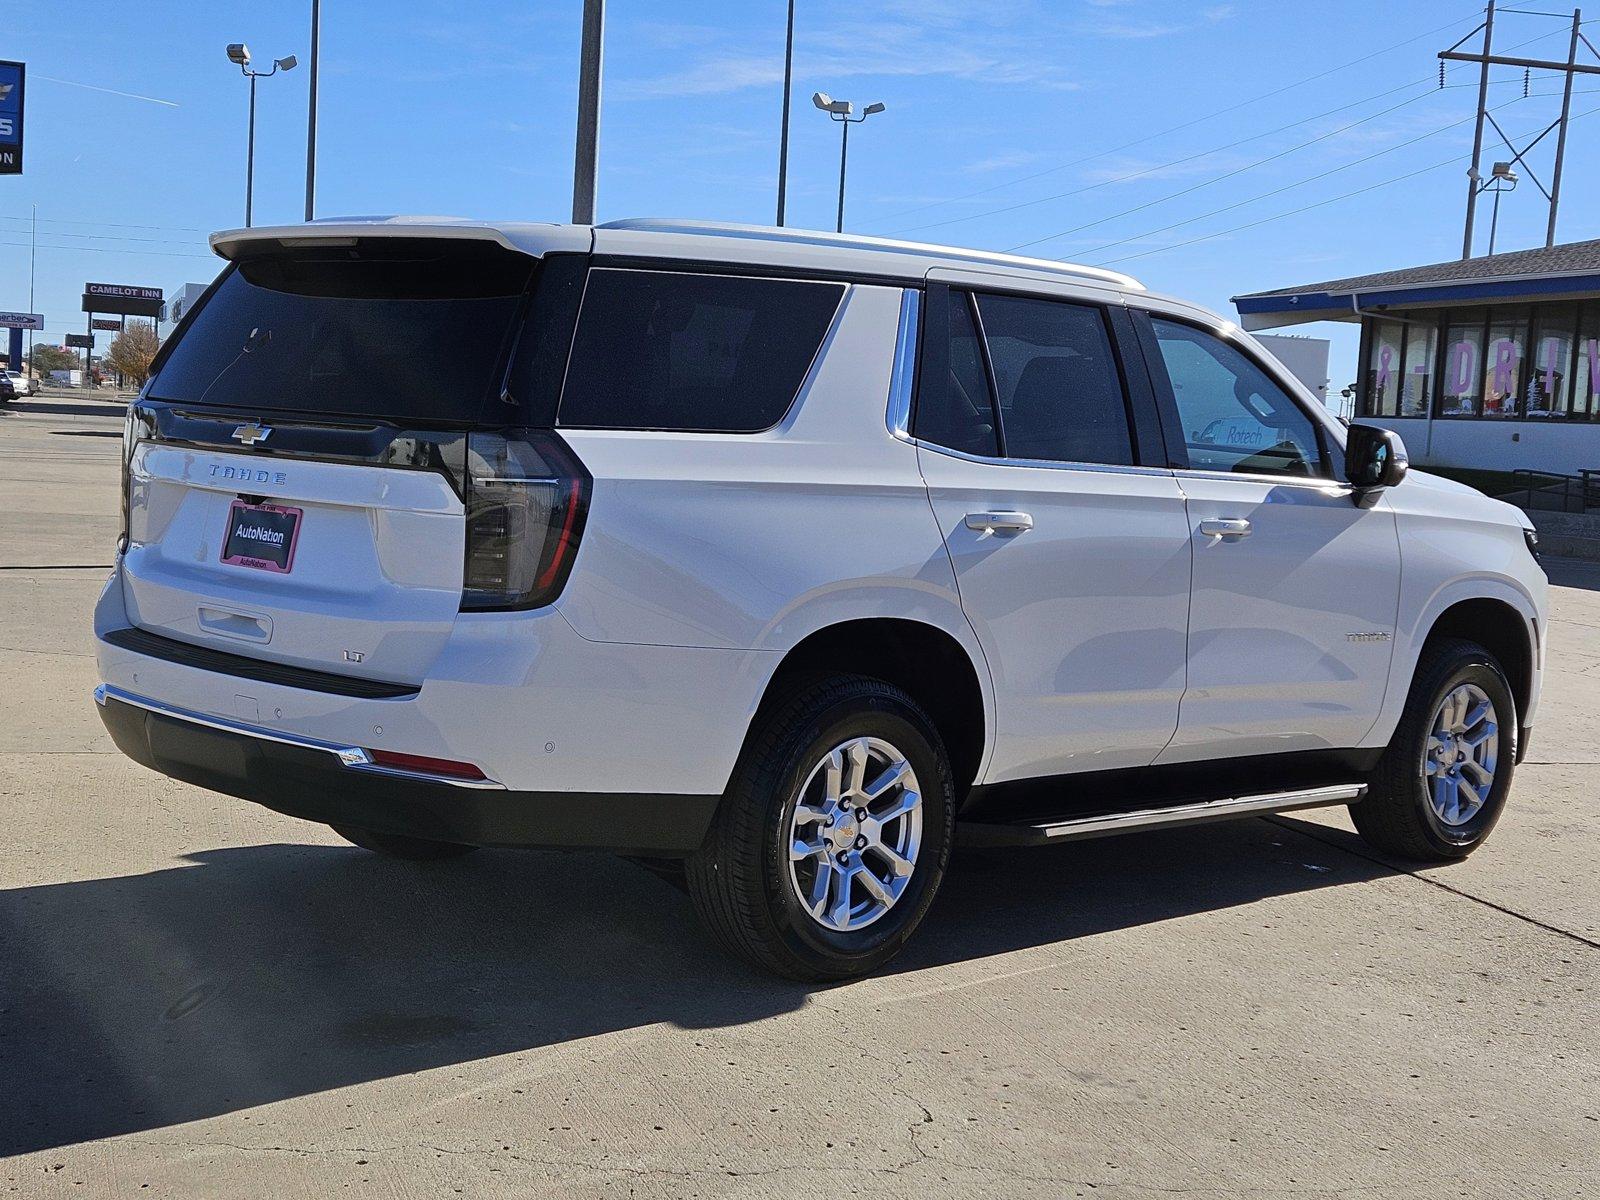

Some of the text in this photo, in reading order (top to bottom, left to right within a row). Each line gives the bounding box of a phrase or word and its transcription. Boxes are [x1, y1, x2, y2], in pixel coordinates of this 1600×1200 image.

[90, 285, 160, 298] CAMELOT INN
[1226, 426, 1263, 444] Rotech
[209, 464, 287, 485] TAHOE
[235, 524, 284, 544] AutoNation
[343, 649, 365, 663] LT
